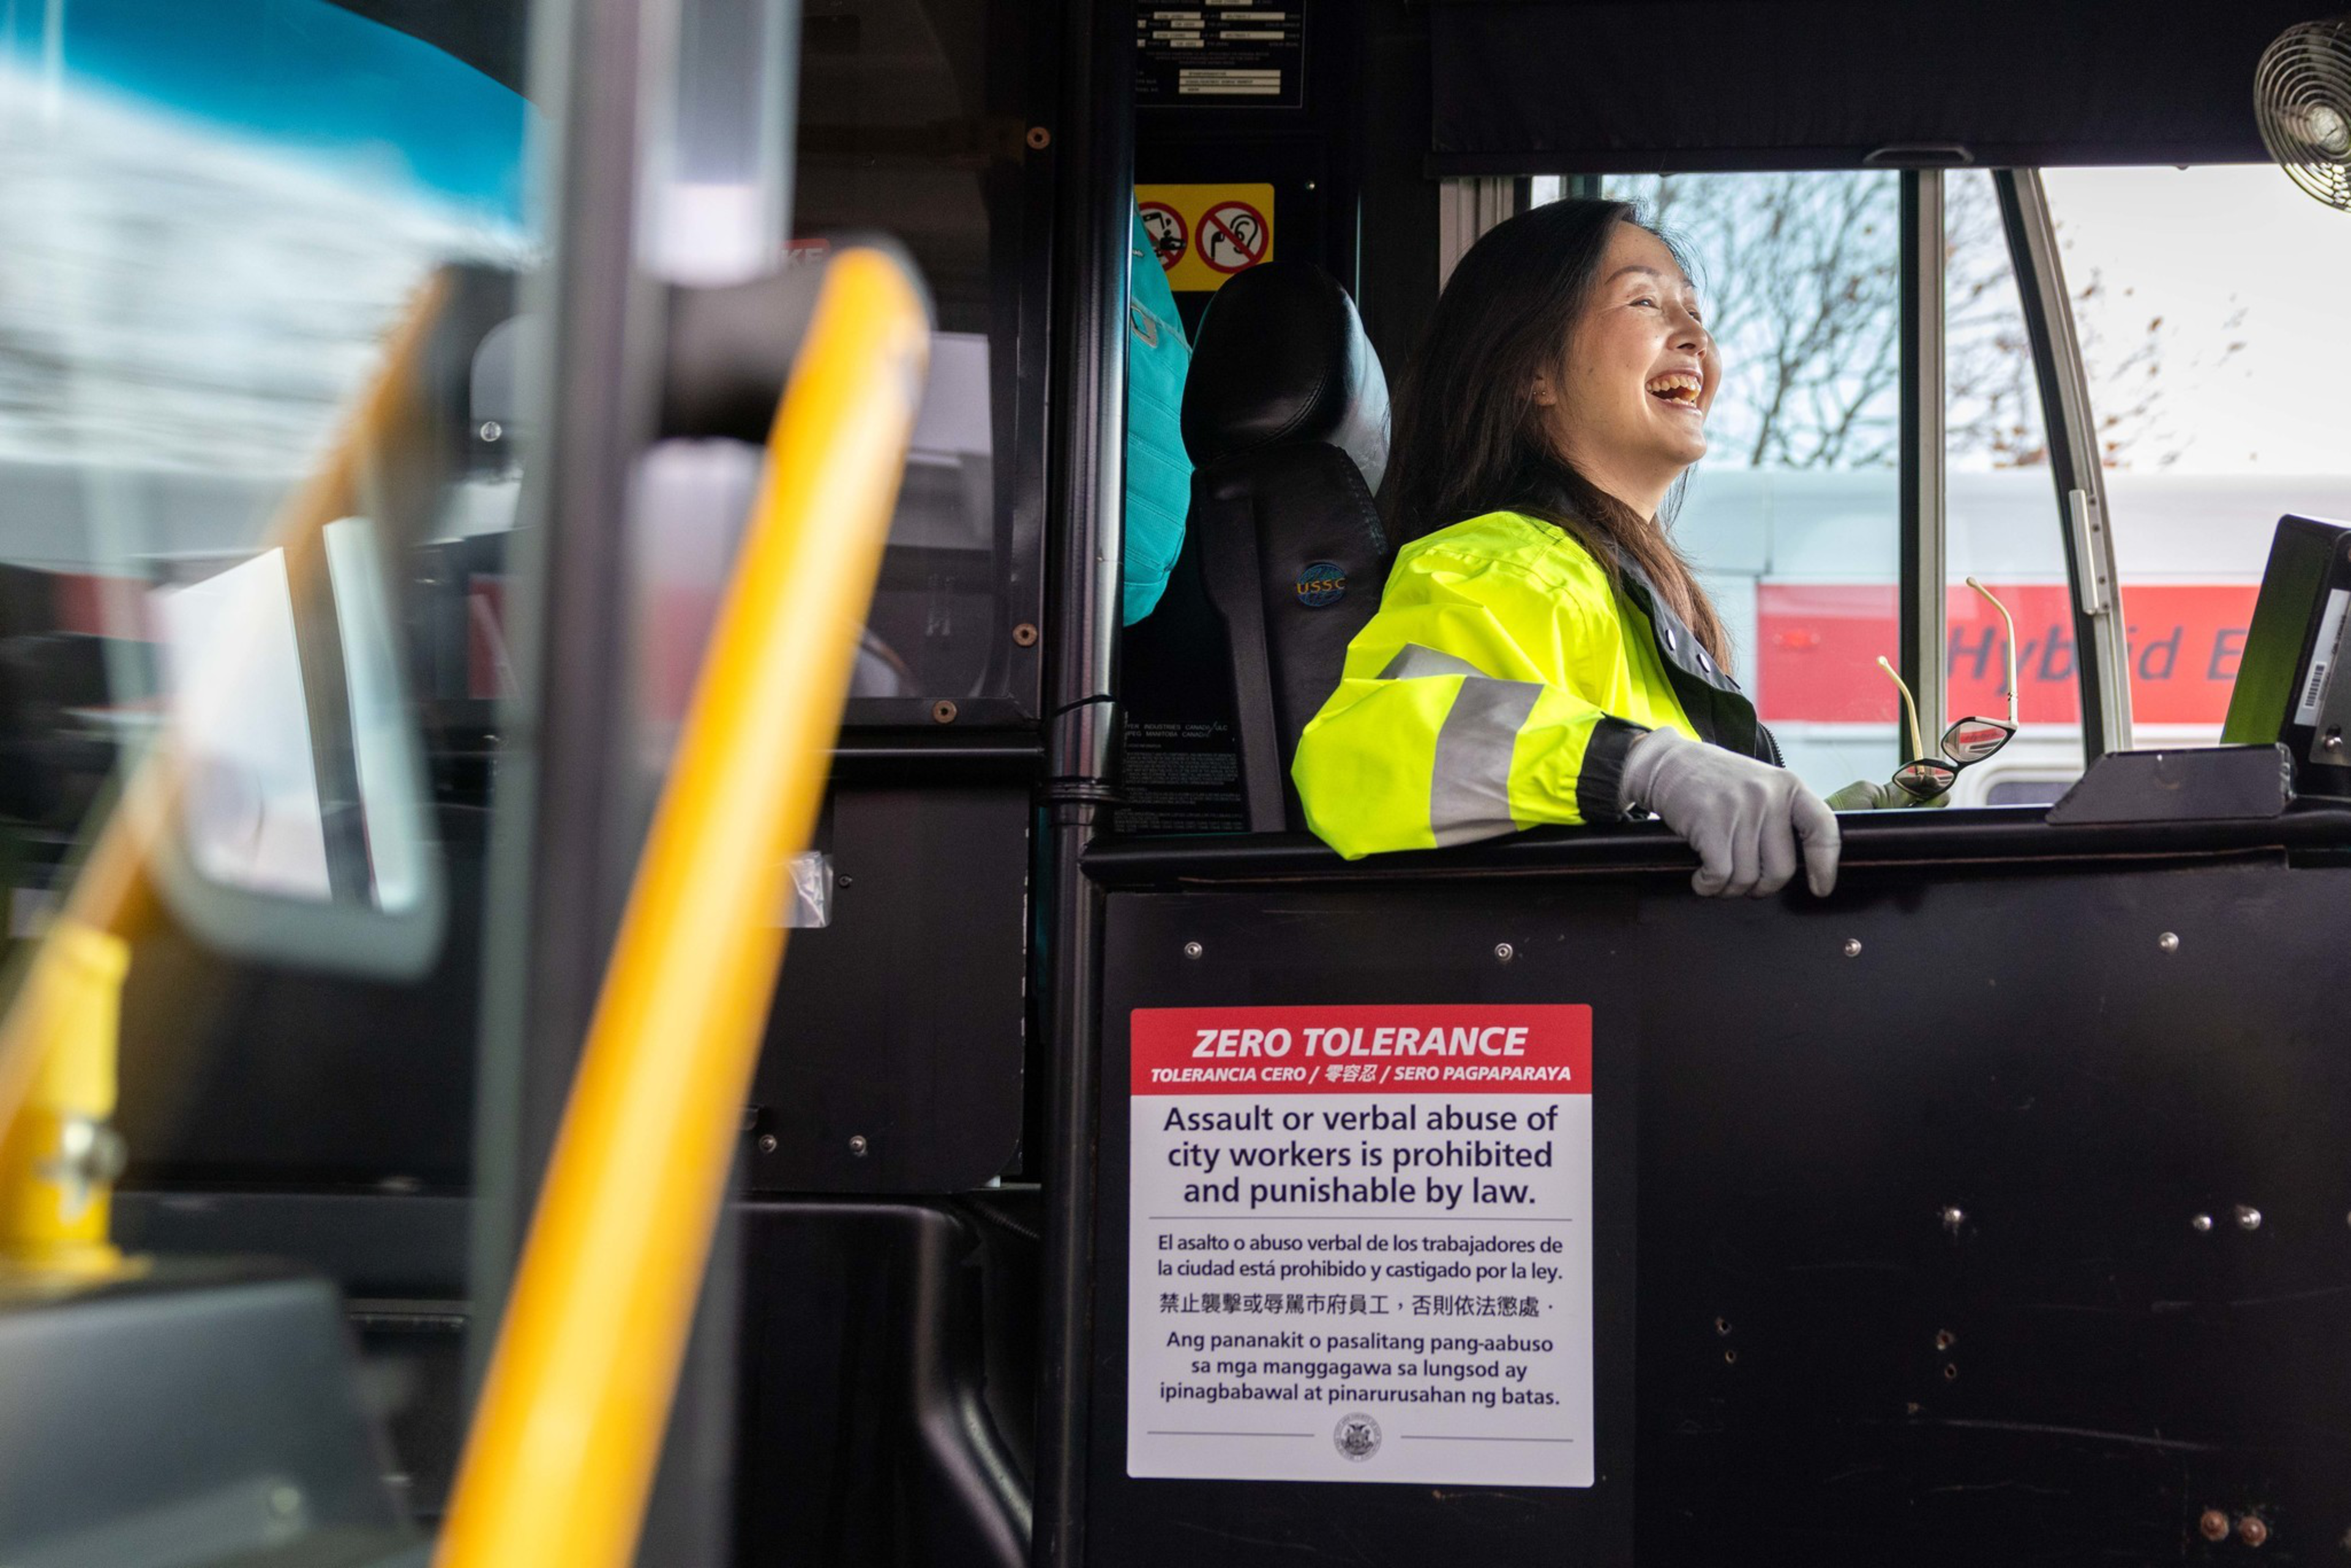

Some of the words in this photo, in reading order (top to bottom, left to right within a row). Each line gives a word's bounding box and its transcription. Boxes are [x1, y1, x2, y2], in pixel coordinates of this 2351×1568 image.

[1295, 577, 1346, 595] USSC
[1192, 1027, 1292, 1058] ZERO
[1303, 1026, 1529, 1057] TOLERANCE
[1151, 1067, 1257, 1082] TOLERANCIA
[1261, 1067, 1307, 1081] CERO
[1325, 1063, 1378, 1082] 零容忍
[1393, 1066, 1440, 1081] SERO
[1442, 1066, 1572, 1081] PAGPAPARAYA
[1163, 1104, 1273, 1131] Assault
[1282, 1111, 1314, 1131] or
[1322, 1103, 1416, 1131] verbal
[1426, 1103, 1517, 1131] abuse
[1527, 1104, 1559, 1131] of
[1168, 1141, 1221, 1174] city
[1229, 1139, 1351, 1167] workers
[1361, 1140, 1383, 1167] is
[1393, 1139, 1552, 1174] prohibited
[1183, 1176, 1240, 1203] and
[1250, 1176, 1416, 1210] punishable
[1426, 1176, 1463, 1210] by
[1473, 1176, 1535, 1204] law.
[1158, 1233, 1173, 1251] El
[1177, 1233, 1230, 1251] asalto
[1233, 1238, 1246, 1251] o
[1249, 1233, 1303, 1251] abuso
[1307, 1234, 1362, 1251] verbal
[1366, 1234, 1389, 1251] de
[1393, 1234, 1419, 1252] los
[1421, 1234, 1535, 1256] trabajadores
[1539, 1236, 1564, 1254] de
[1158, 1259, 1173, 1277] la
[1177, 1259, 1235, 1277] ciudad
[1239, 1259, 1276, 1277] está
[1280, 1259, 1367, 1281] prohibido
[1370, 1265, 1382, 1282] y
[1385, 1260, 1472, 1283] castigado
[1476, 1266, 1508, 1283] por
[1511, 1261, 1527, 1279] la
[1531, 1261, 1563, 1284] ley.
[1166, 1331, 1205, 1352] Ang
[1210, 1331, 1305, 1352] pananakit
[1309, 1335, 1322, 1349] o
[1327, 1332, 1425, 1354] pasalitang
[1430, 1334, 1554, 1355] pang-aabuso
[1191, 1360, 1211, 1374] sa
[1217, 1361, 1258, 1379] mga
[1263, 1361, 1392, 1380] manggagawa
[1397, 1363, 1417, 1376] sa
[1423, 1359, 1499, 1382] lungsod
[1505, 1365, 1528, 1383] ay
[1160, 1381, 1299, 1404] ipinagbabawal
[1303, 1386, 1323, 1401] at
[1328, 1384, 1466, 1406] pinarurusahan
[1472, 1390, 1496, 1408] ng
[1502, 1386, 1560, 1405] batas.
